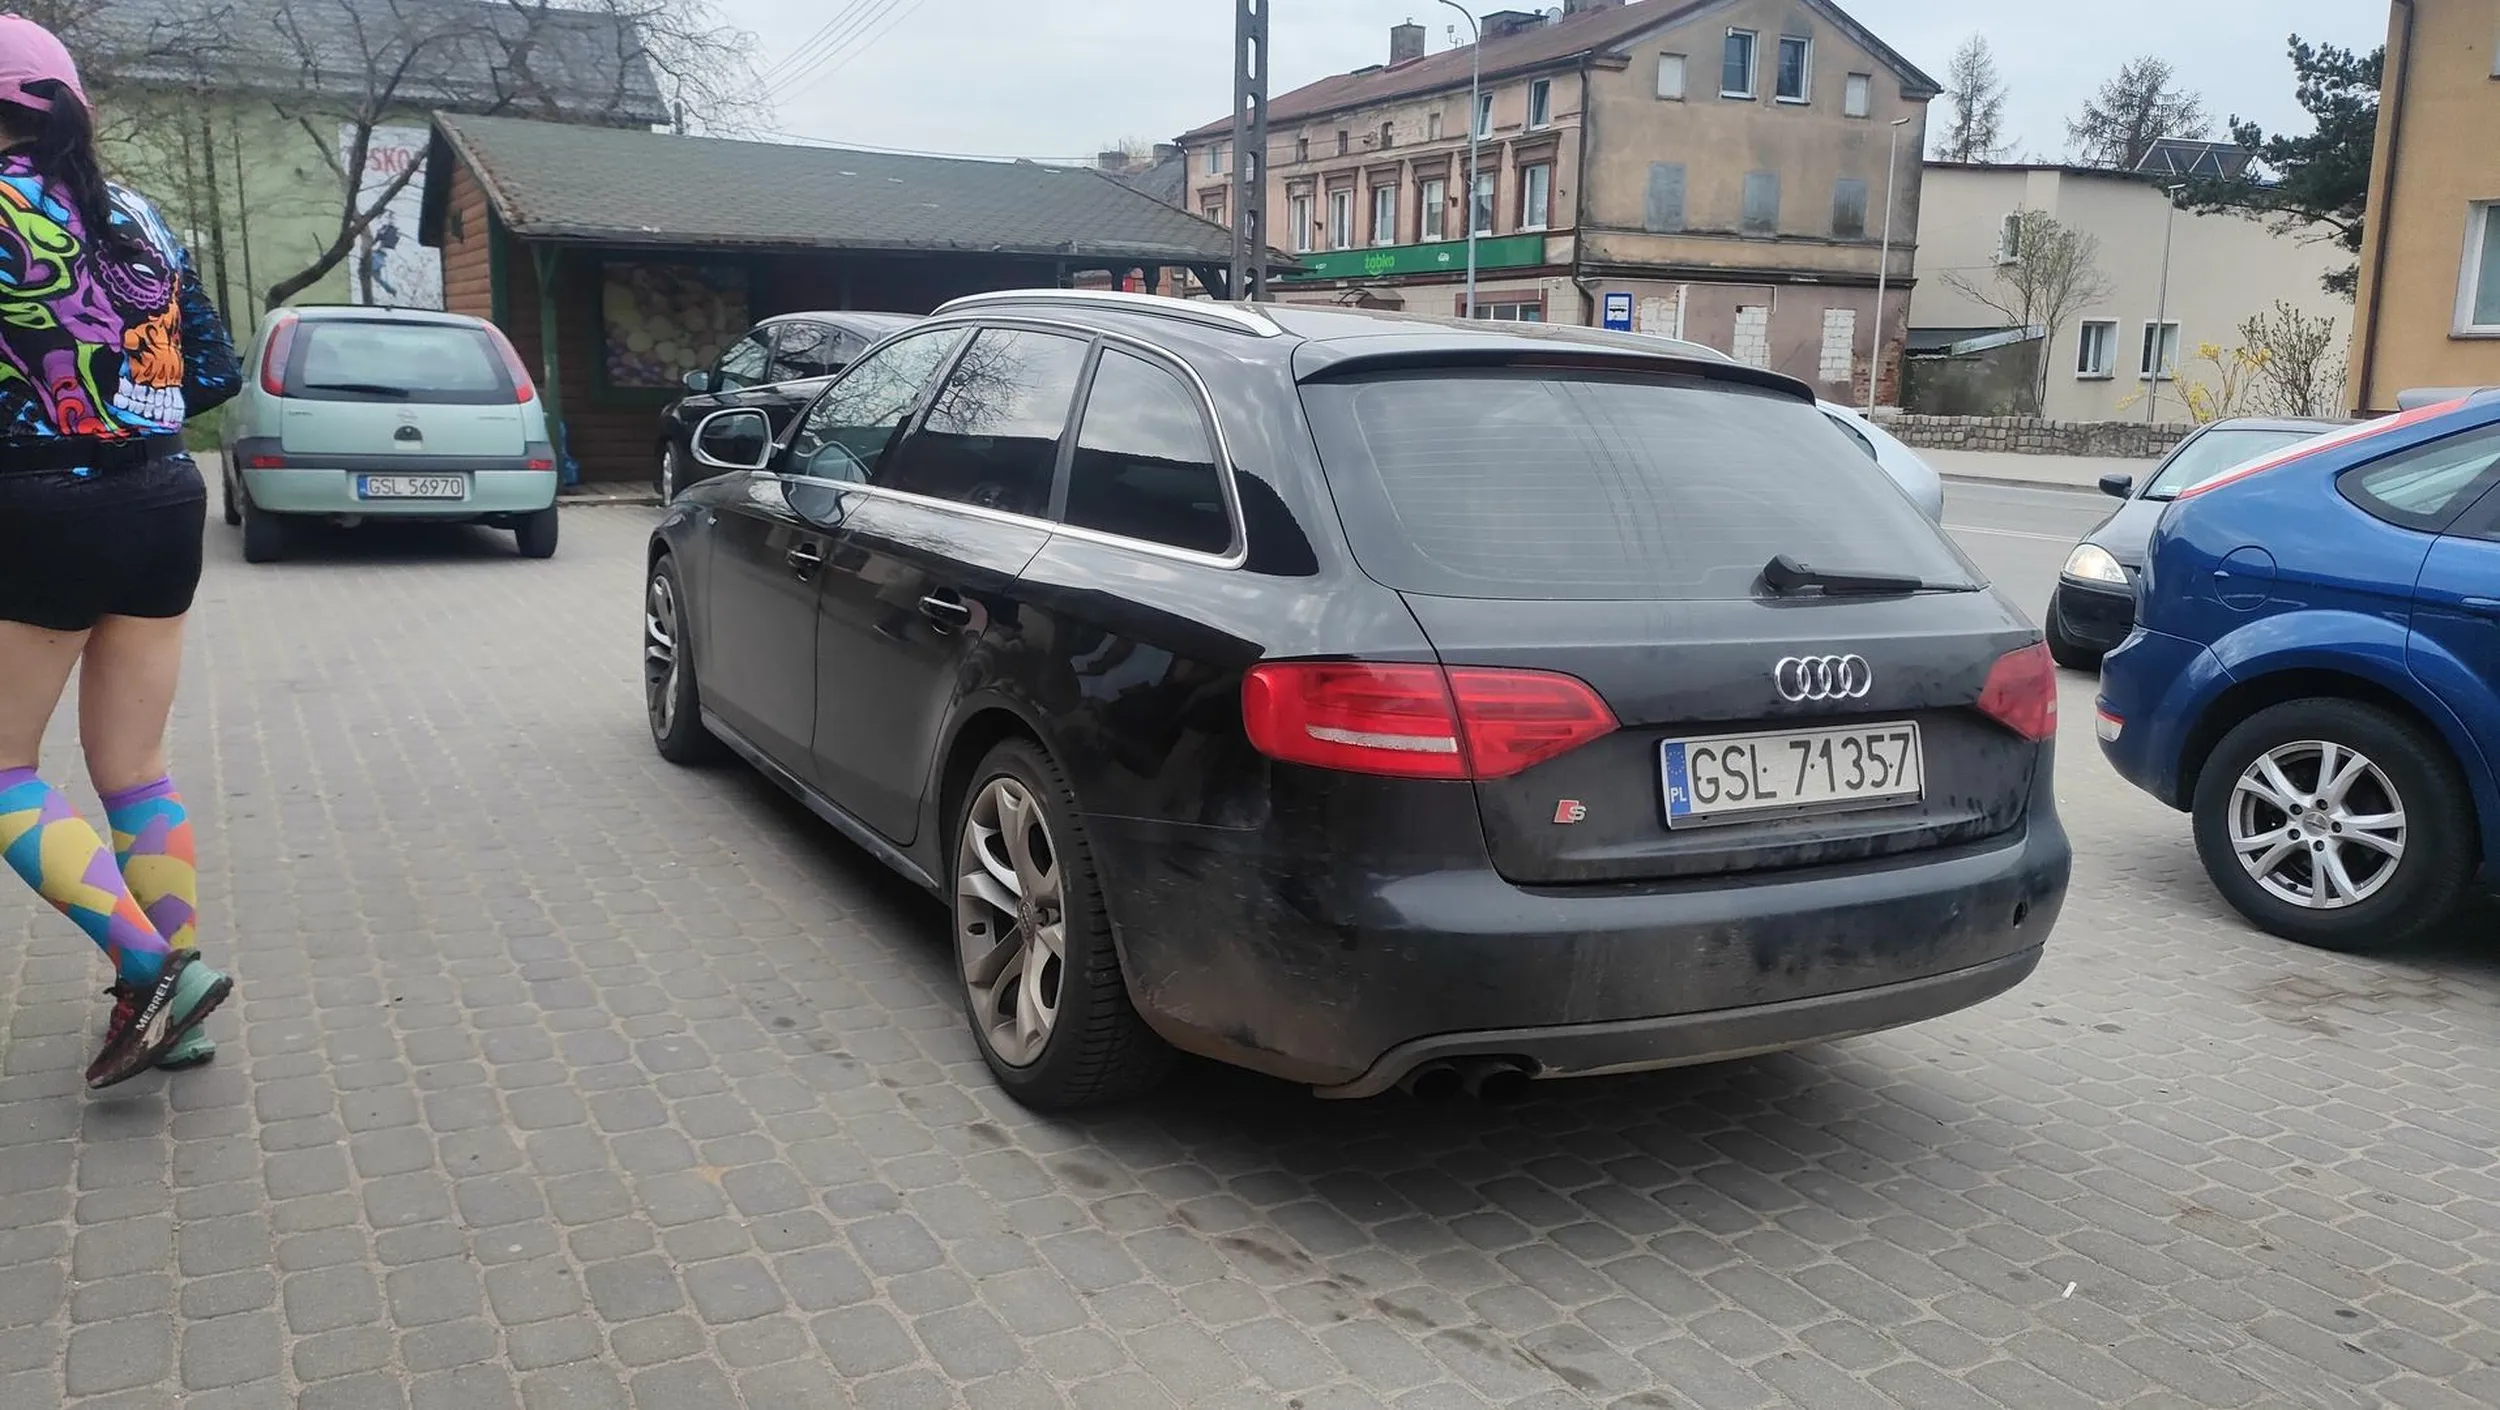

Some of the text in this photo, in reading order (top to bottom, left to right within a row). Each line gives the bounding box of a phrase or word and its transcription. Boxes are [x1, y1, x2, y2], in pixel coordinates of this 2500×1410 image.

[369, 478, 461, 495] GSL 56970
[1691, 731, 1910, 804] GSL 71357
[1669, 786, 1688, 804] PL
[135, 973, 176, 1031] MERRELL
